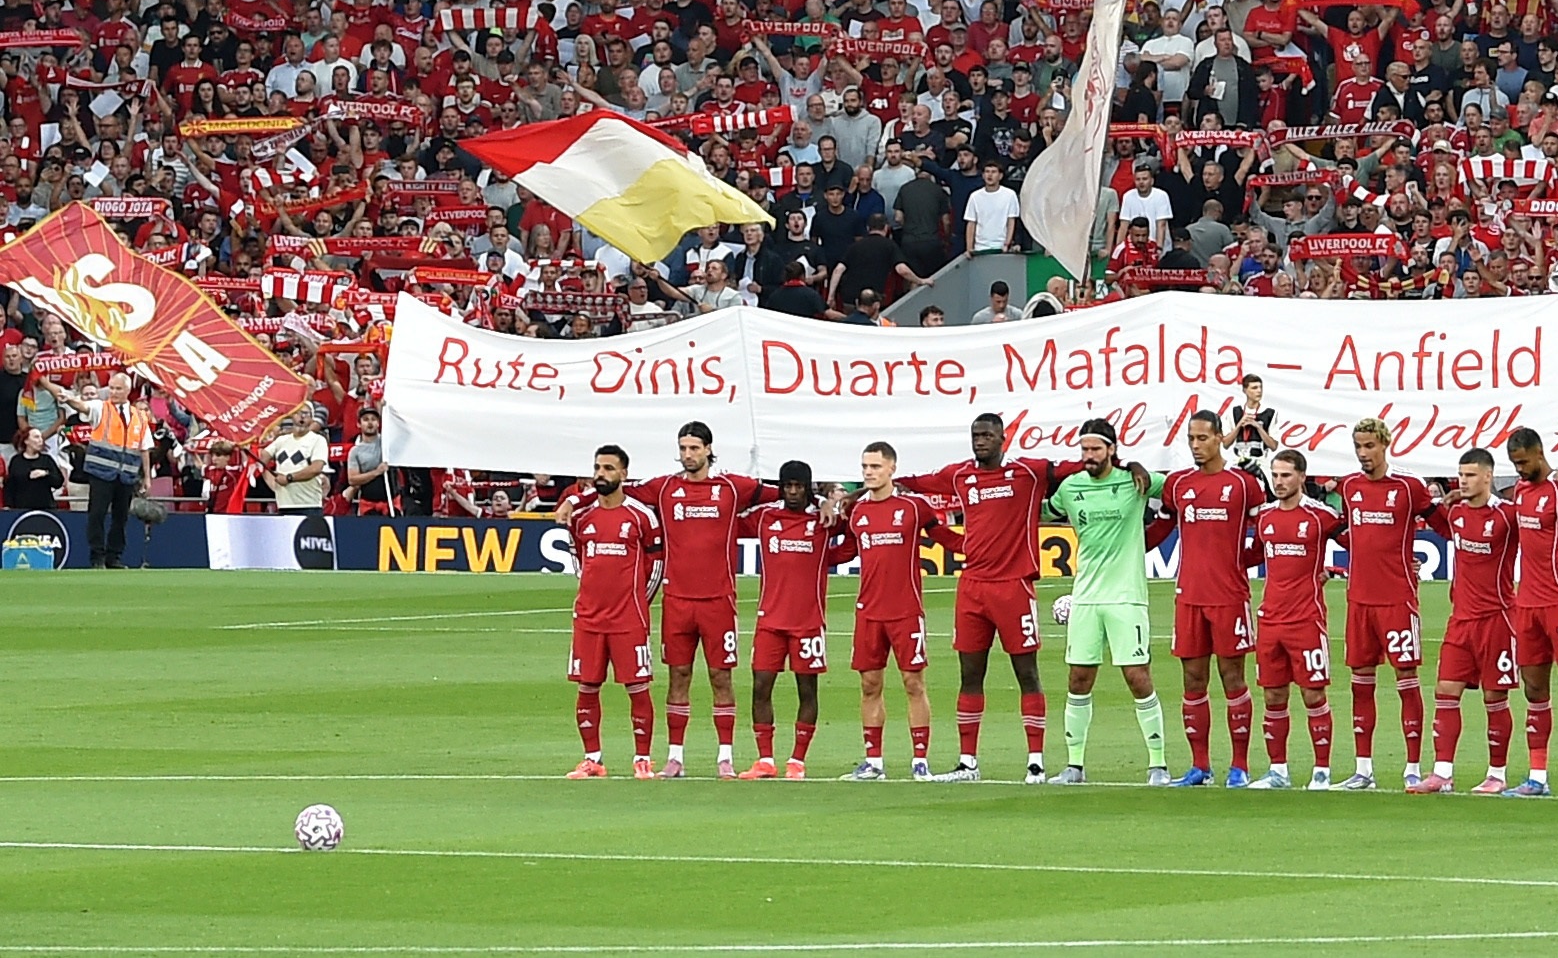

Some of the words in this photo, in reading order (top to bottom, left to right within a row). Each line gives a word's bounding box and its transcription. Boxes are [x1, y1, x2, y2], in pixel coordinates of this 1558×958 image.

[23, 28, 58, 39] FOOTBALL
[750, 20, 829, 35] LIVERPOOL
[846, 40, 919, 56] LIVERPOOL
[401, 106, 417, 117] FC
[208, 119, 291, 131] MACEDONIA
[1287, 126, 1320, 140] ALLEZ
[1323, 123, 1360, 137] ALLEZ
[1361, 121, 1395, 134] ALLEZ
[1175, 129, 1235, 142] LIVERPOOL
[1236, 129, 1252, 141] FC
[404, 181, 436, 191] MIGHTY
[95, 200, 127, 214] DIOGO
[128, 200, 154, 214] JOTA
[440, 209, 487, 220] LIVERPOOL
[337, 239, 397, 248] LIVERPOOL
[398, 239, 410, 248] FC
[1308, 237, 1373, 250] LIVERPOOL
[1376, 237, 1391, 248] FC
[1135, 268, 1186, 278] LIVERPOOL
[1189, 268, 1202, 277] FC
[36, 354, 82, 373] DIOGO
[84, 353, 124, 369] JOTA
[434, 337, 566, 401] Rute,
[590, 340, 738, 404] Dinis,
[761, 340, 977, 405] Duarte,
[1003, 324, 1244, 393] Mafalda
[1324, 326, 1543, 392] Anfield
[1165, 394, 1348, 454] Ner
[1380, 403, 1525, 457] Walk
[377, 525, 523, 573] NEW
[1020, 614, 1034, 636] 5
[1135, 625, 1142, 645] 1
[1234, 616, 1247, 638] 4
[723, 630, 736, 653] 8
[798, 636, 823, 659] 30
[910, 632, 923, 654] 7
[1386, 629, 1414, 653] 22
[634, 645, 648, 667] 11
[1302, 648, 1325, 672] 10
[1497, 649, 1512, 672] 6
